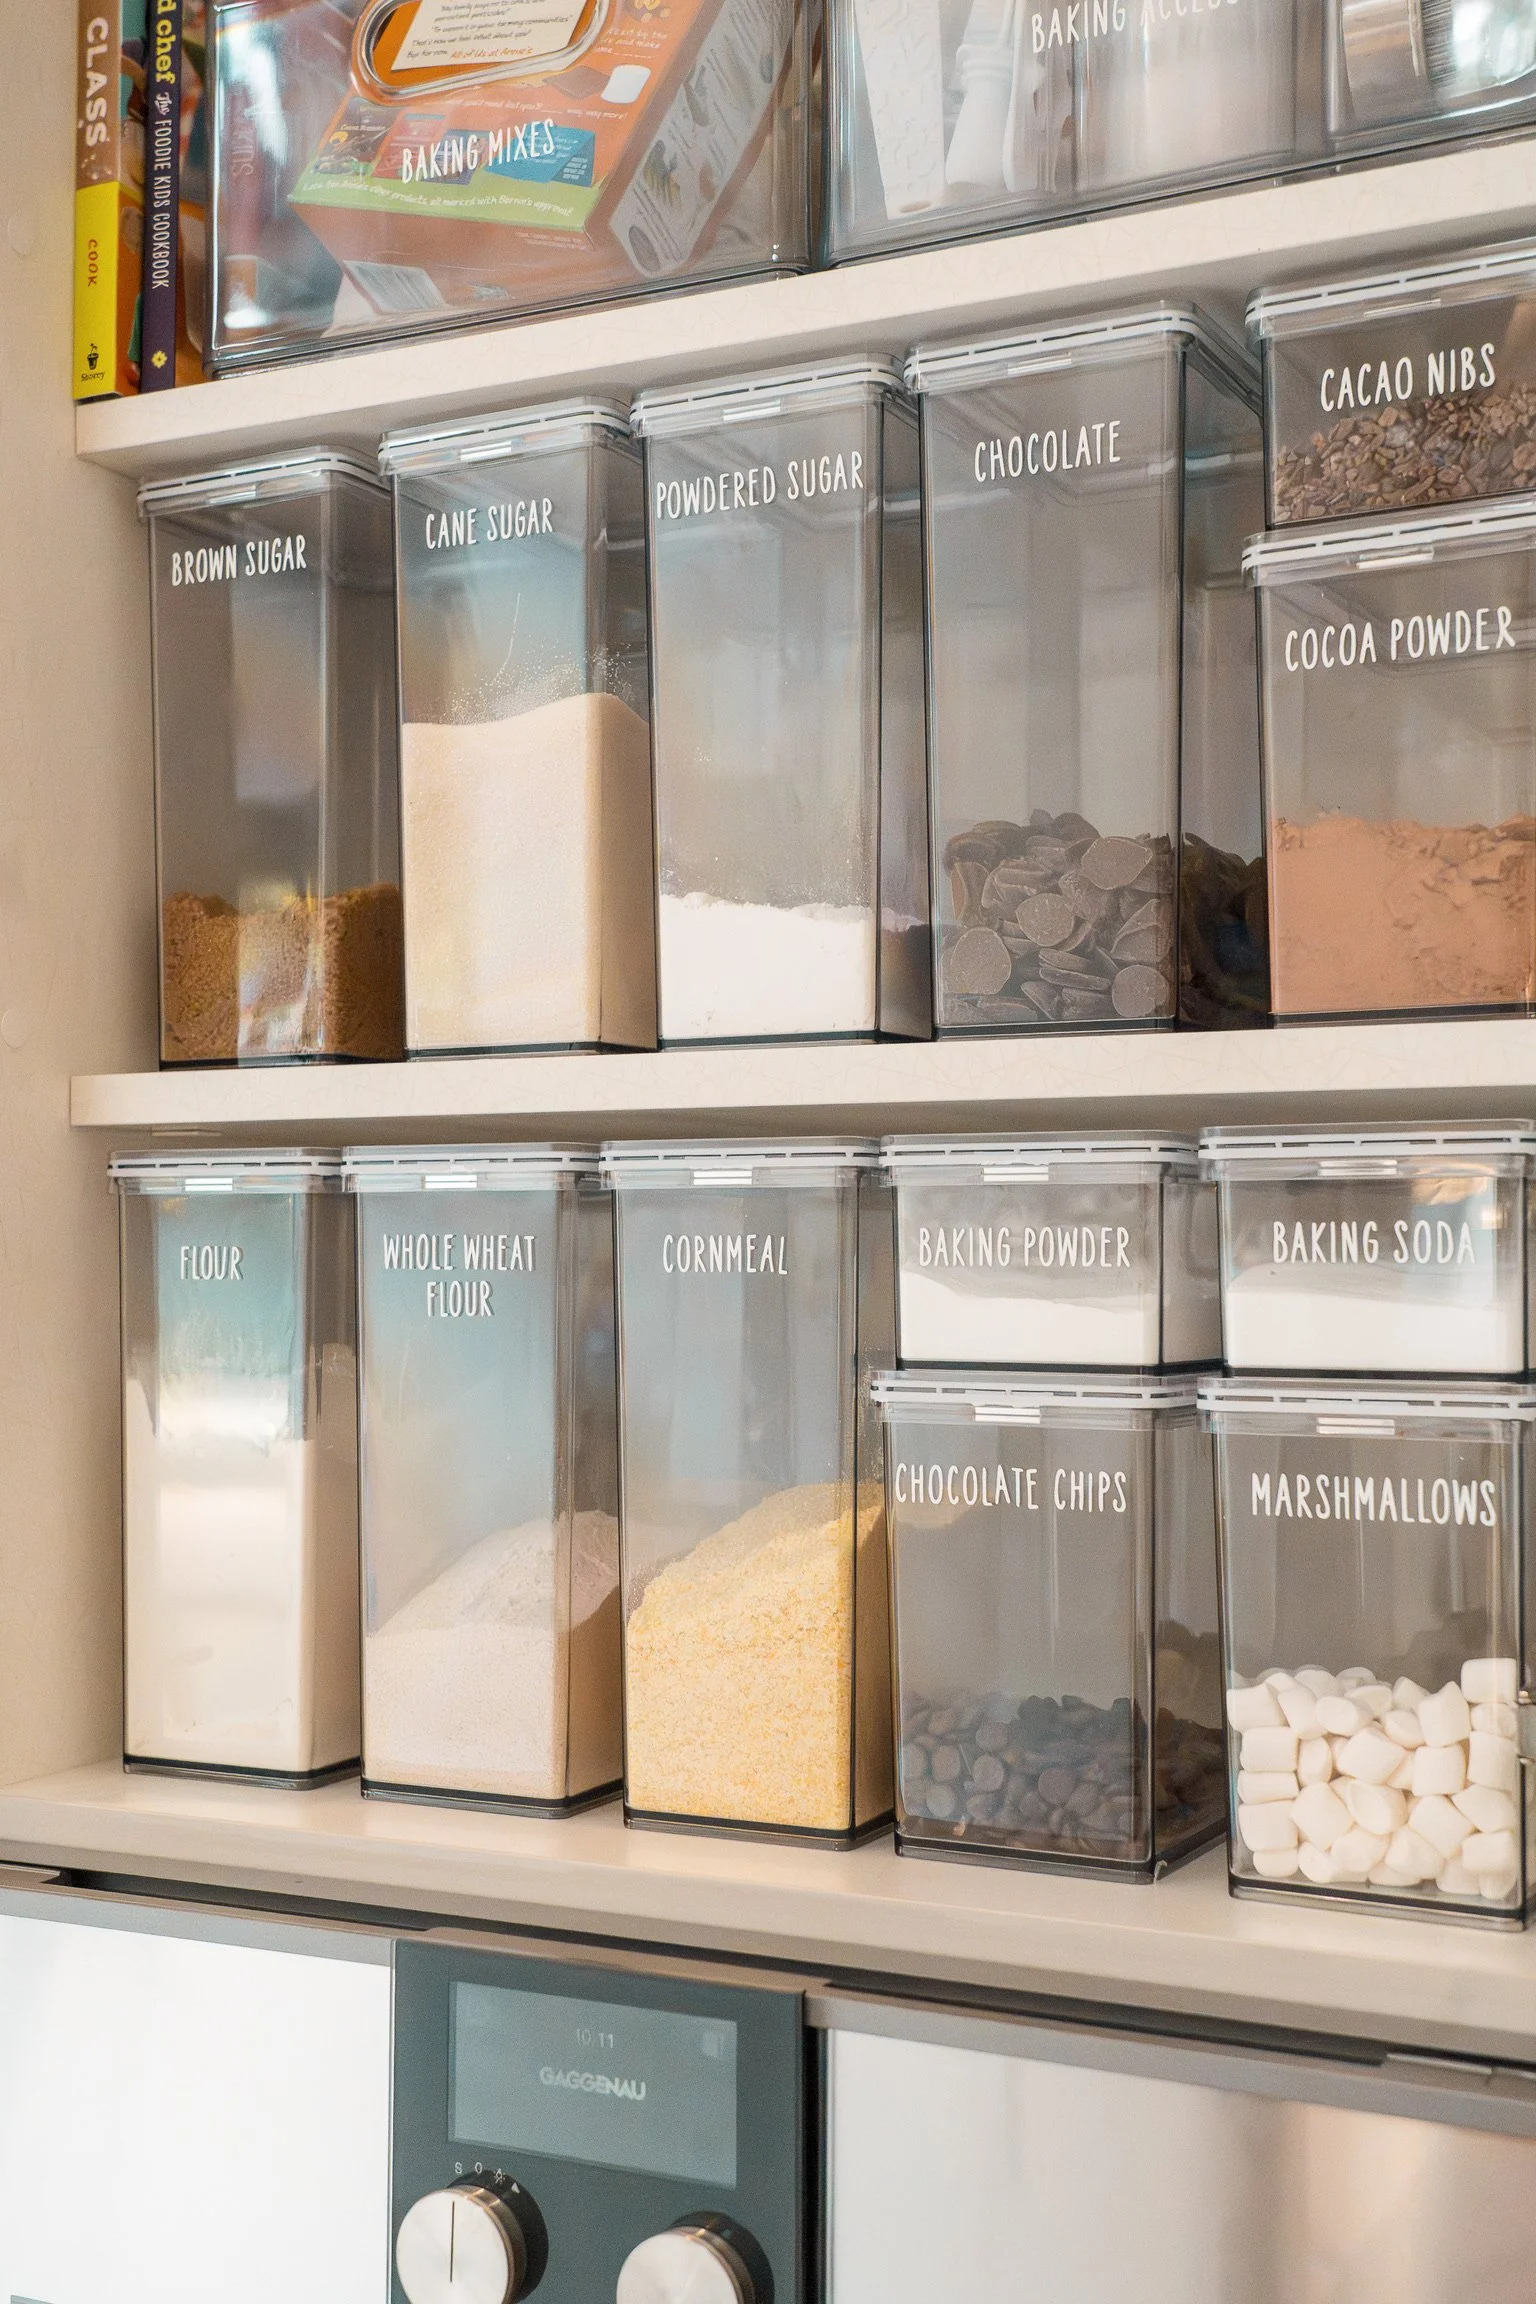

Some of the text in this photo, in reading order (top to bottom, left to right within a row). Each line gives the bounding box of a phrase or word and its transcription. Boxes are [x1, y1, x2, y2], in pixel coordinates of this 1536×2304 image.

[156, 19, 177, 85] chef
[1031, 0, 1126, 53] BAKING
[85, 16, 109, 147] CLASS
[154, 119, 172, 171] FOODIE
[402, 135, 479, 184] BAKING
[488, 118, 555, 167] MIXES
[153, 176, 171, 208] KIDS
[87, 239, 99, 287] COOK
[152, 213, 171, 289] COOKBOOK
[1320, 342, 1496, 413] CACAO NIBS
[974, 420, 1121, 483] CHOCOLATE
[655, 450, 864, 521] POWDERED SUGAR
[425, 497, 553, 550] CANE SUGAR
[171, 534, 307, 587] BROWN SUGAR
[1285, 605, 1517, 672] COCOA POWDER
[180, 1245, 243, 1281] FLOUR
[383, 1233, 536, 1272] WHOLE WHEAT
[662, 1233, 789, 1276] CORNMEAL
[919, 1226, 1130, 1268] BAKING POWDER
[1273, 1219, 1476, 1264] BAKING SODA
[427, 1279, 493, 1318] FLOUR
[894, 1462, 1127, 1514] CHOCOLATE CHIPS
[1251, 1472, 1498, 1528] MARSHMALLOWS
[540, 2066, 646, 2101] GAGGENAU
